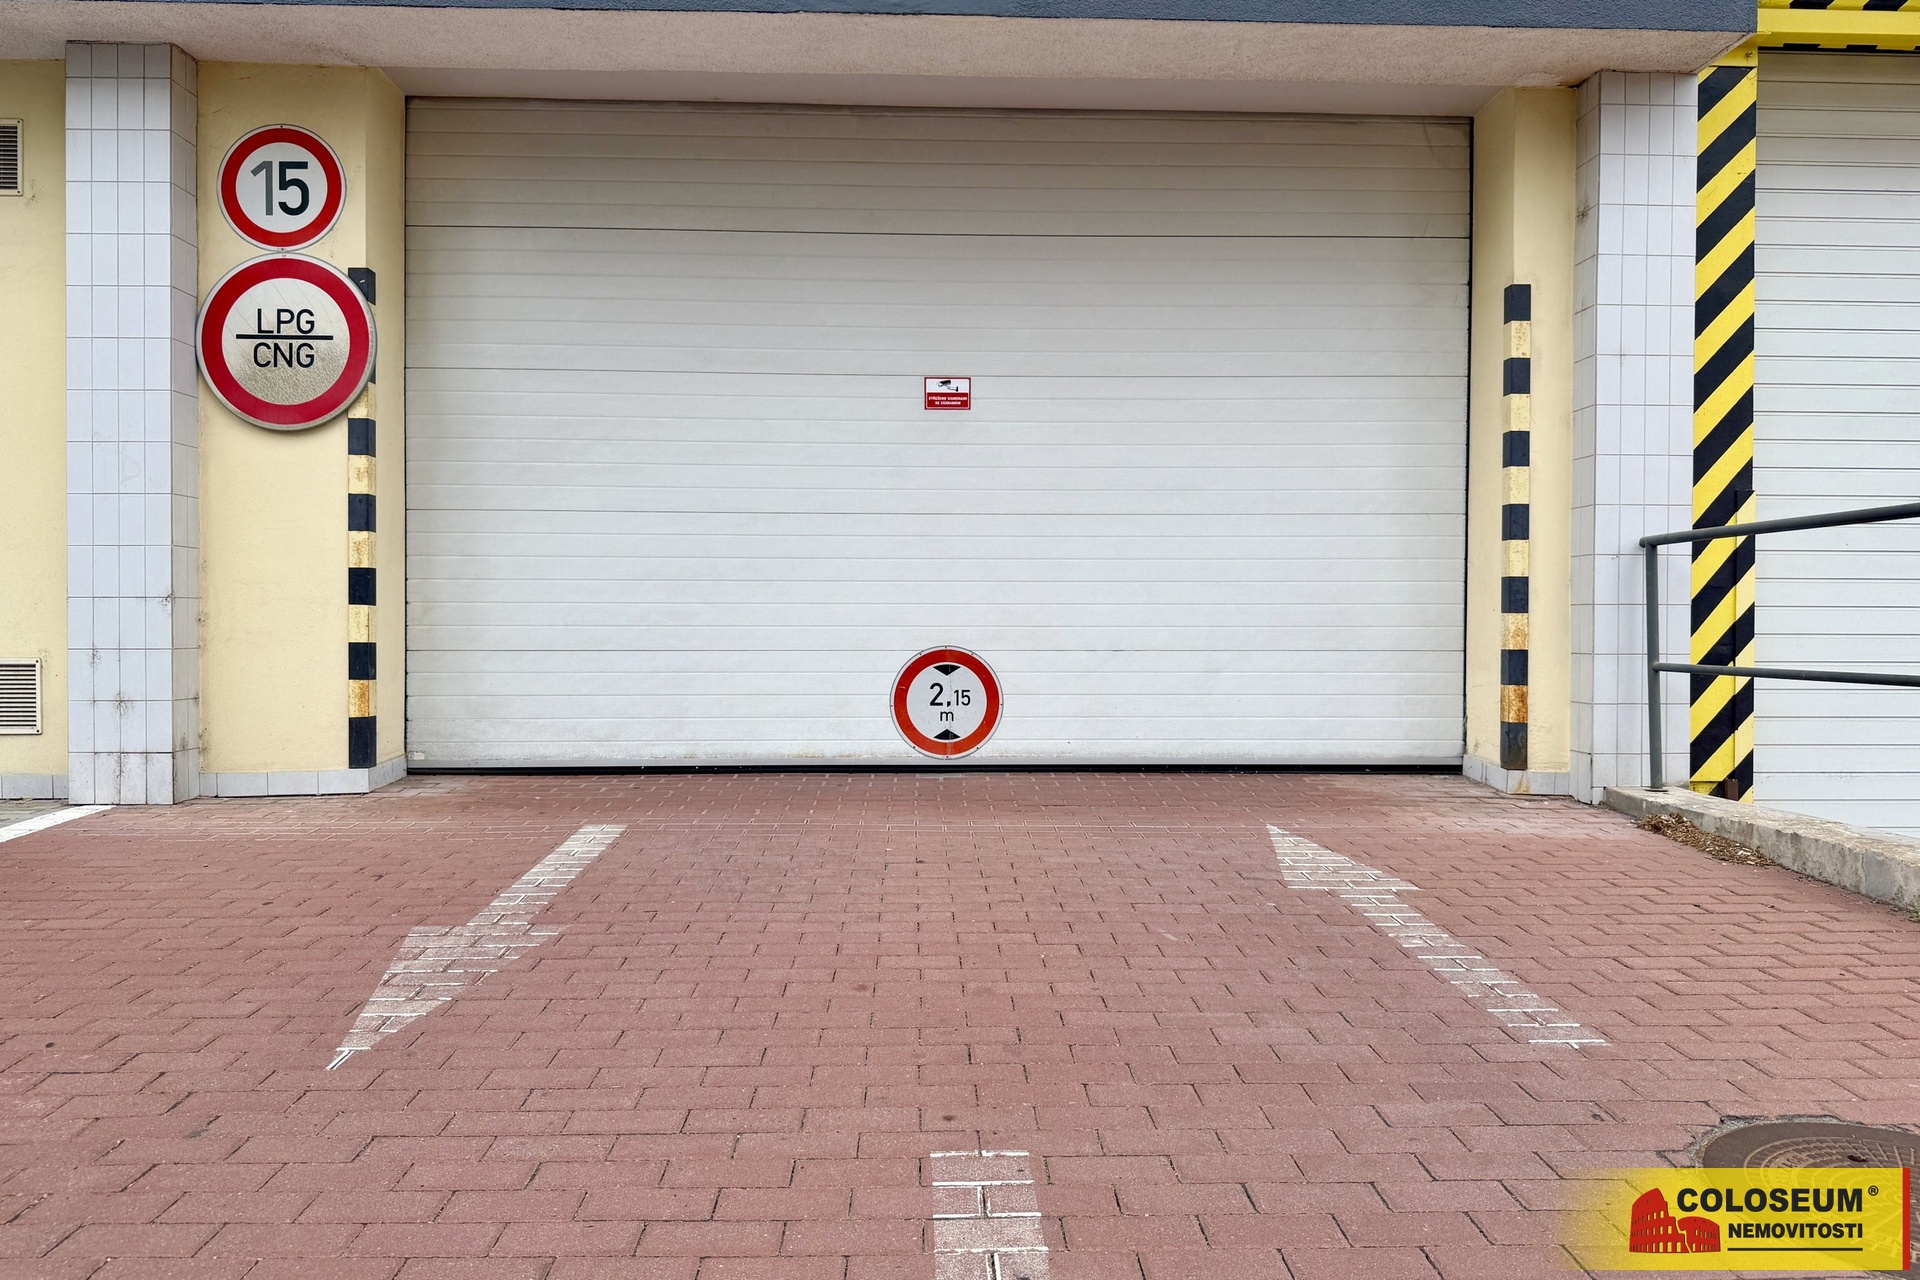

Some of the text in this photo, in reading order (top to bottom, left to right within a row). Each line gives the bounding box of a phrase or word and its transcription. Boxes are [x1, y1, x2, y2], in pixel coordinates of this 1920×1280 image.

[250, 160, 310, 216] 15
[257, 308, 315, 335] LPG
[253, 342, 315, 368] CNG
[929, 682, 971, 708] 2,15
[939, 711, 954, 722] m
